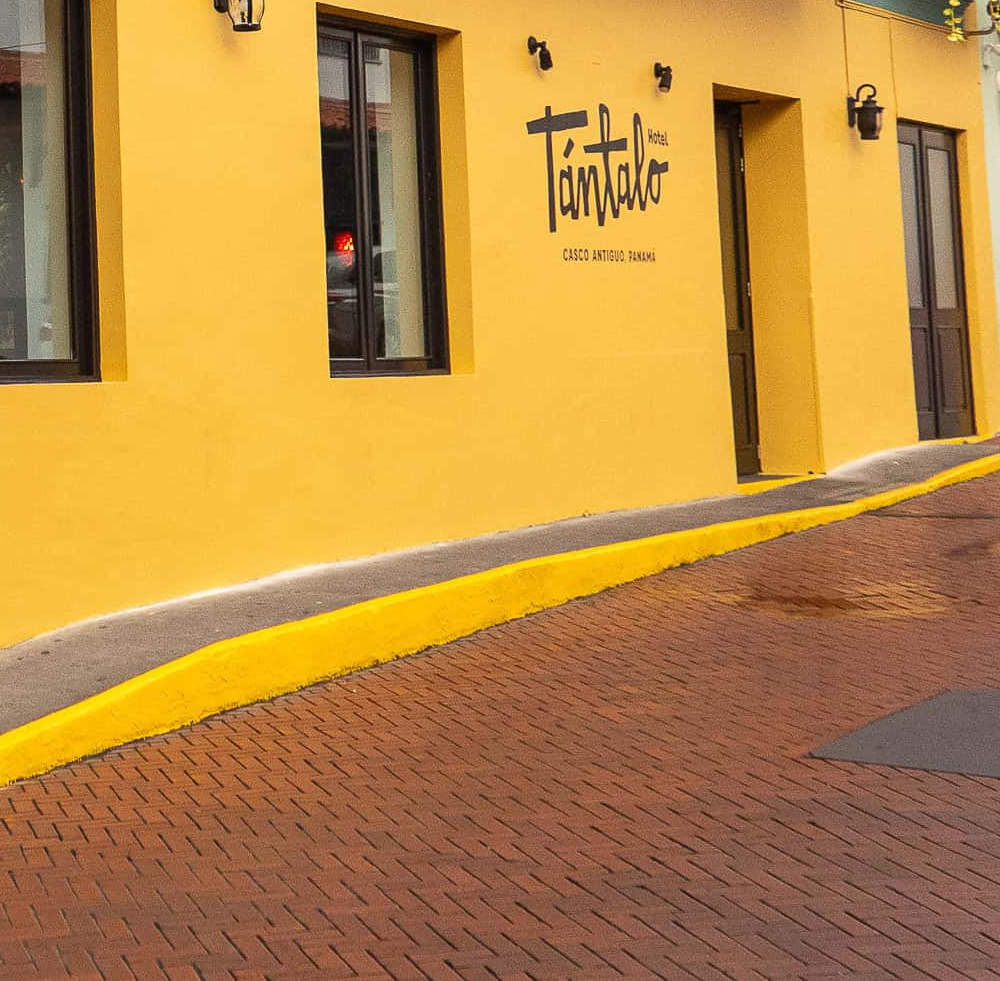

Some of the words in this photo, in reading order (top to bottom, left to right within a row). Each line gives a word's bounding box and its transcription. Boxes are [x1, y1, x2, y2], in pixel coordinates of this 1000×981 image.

[648, 128, 669, 146] Hotel
[526, 103, 669, 234] Tántalo
[563, 248, 588, 261] CASCO
[628, 247, 656, 263] PANAMÁ
